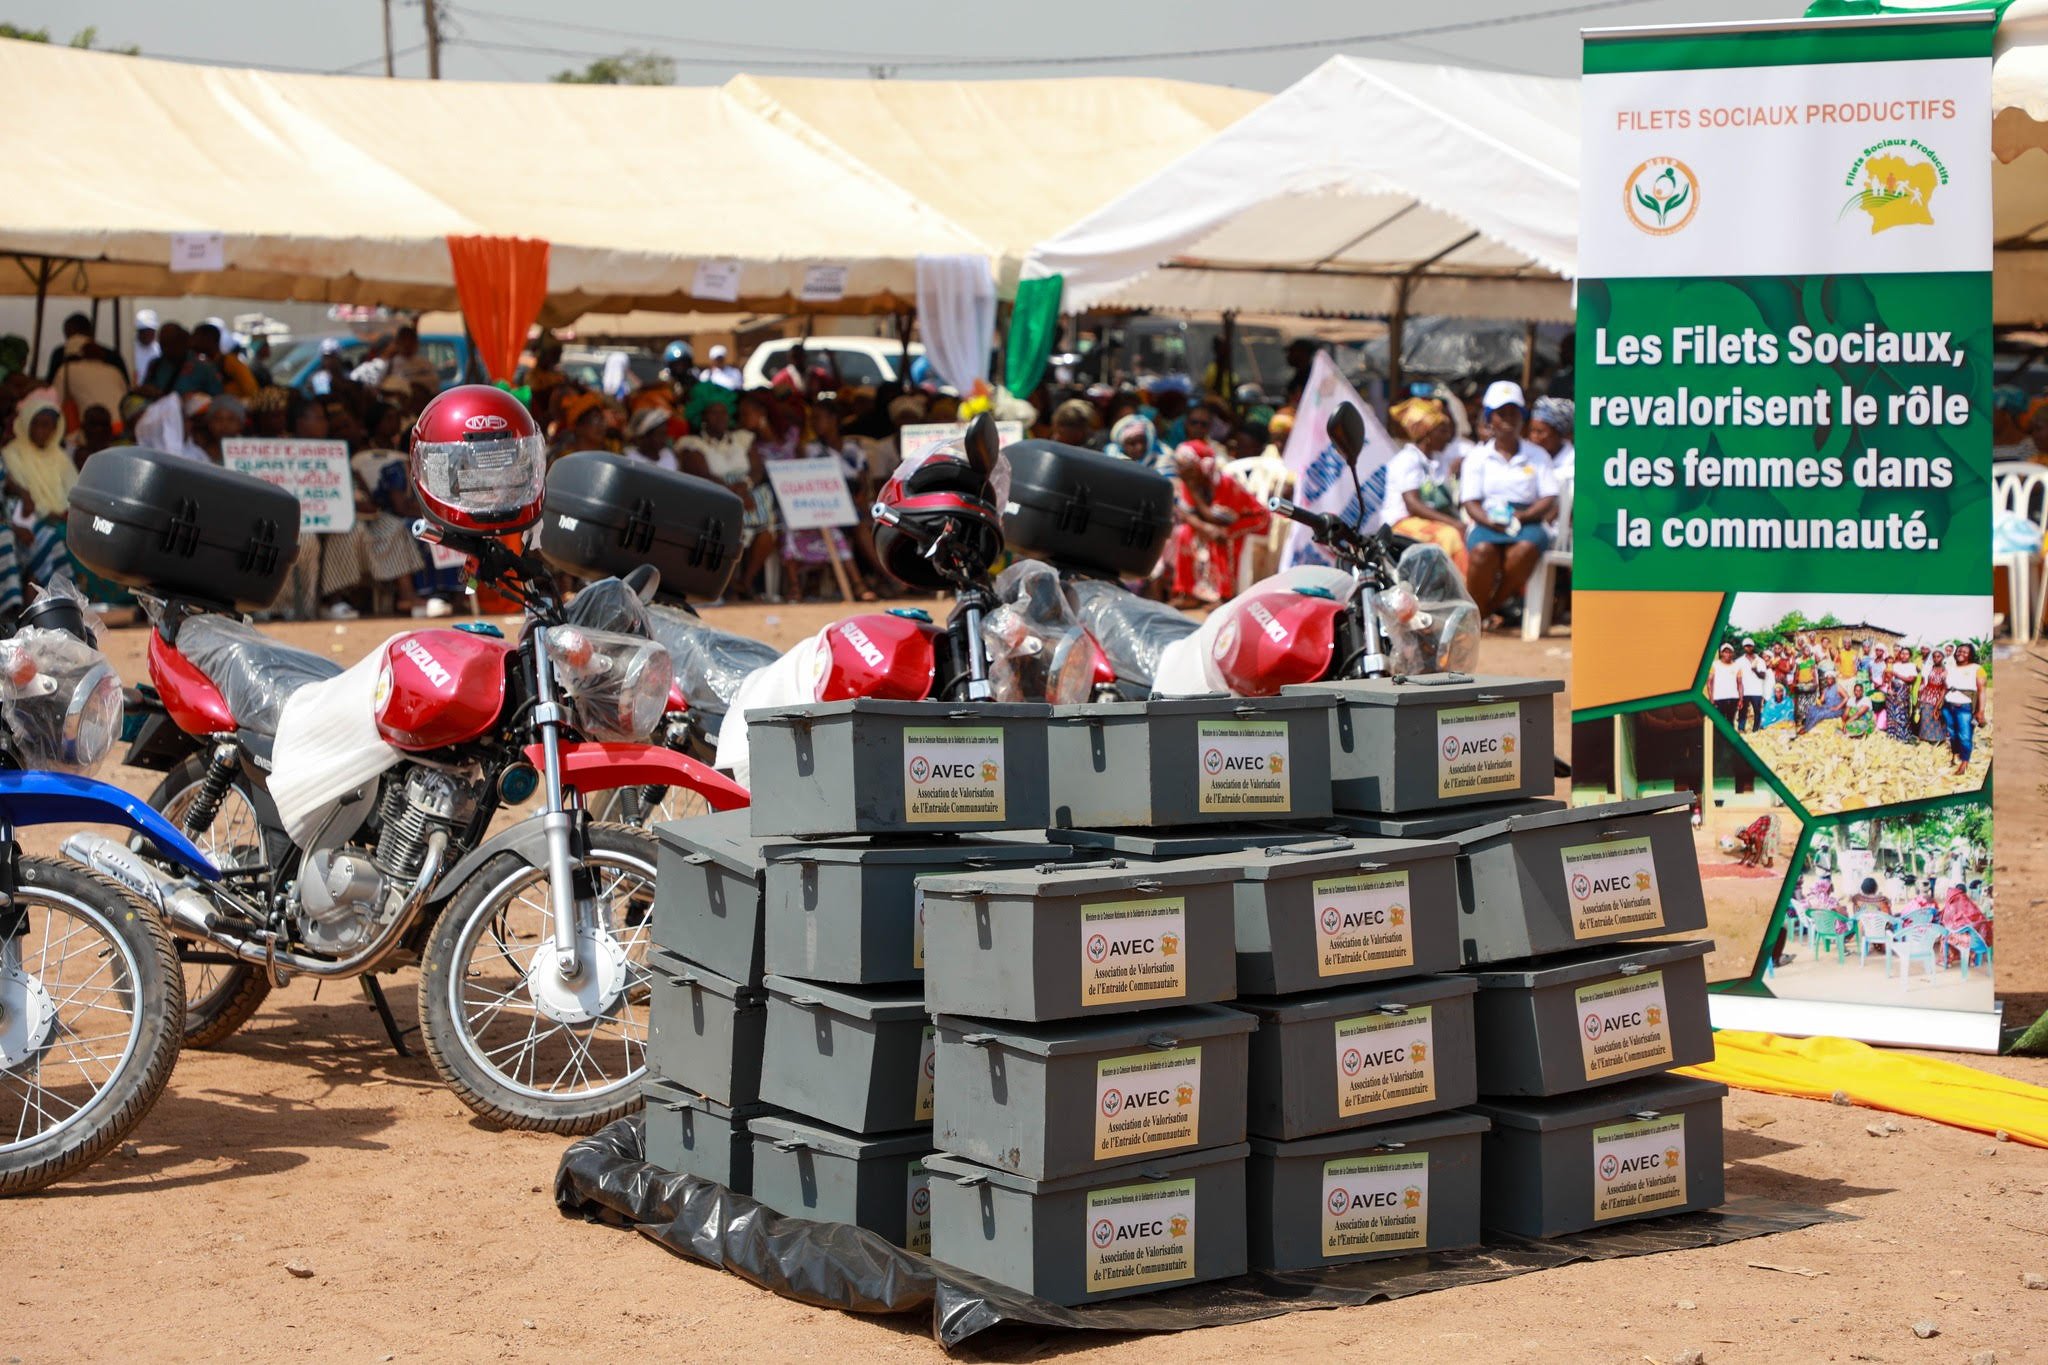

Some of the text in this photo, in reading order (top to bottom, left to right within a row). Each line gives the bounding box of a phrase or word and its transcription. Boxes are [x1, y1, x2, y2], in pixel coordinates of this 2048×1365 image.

[1617, 99, 1956, 131] FILETS SOCIAUX PRODUCTIFS
[1846, 139, 1949, 186] Filets Sociaux Productifs
[1596, 323, 1965, 367] Les Filets Sociaux,
[1590, 385, 1969, 426] revalorisent le rôle
[1604, 448, 1952, 487] des femmes dans
[1617, 509, 1939, 550] la communauté.
[1248, 601, 1288, 643] SUZUKI
[840, 622, 884, 667] SUZUKI
[401, 639, 451, 688] SUZUKI
[1461, 739, 1498, 755] AVEC
[931, 764, 975, 778] AVEC
[1225, 756, 1264, 770] AVEC
[1448, 758, 1512, 775] Association de Valorisation
[917, 787, 995, 799] Association de Valorisation
[1210, 778, 1281, 790] Association de Valorisation
[1443, 779, 1450, 790] de
[911, 802, 999, 814] de l'Entraide Communautaire
[1205, 793, 1213, 804] de
[1593, 876, 1631, 894] AVEC
[1582, 896, 1651, 915] Association de Valorisation
[1343, 910, 1384, 928] AVEC
[1579, 919, 1586, 930] de
[1109, 938, 1154, 957] AVEC
[1329, 931, 1403, 950] Association de Valorisation
[1324, 946, 1407, 966] de l'Entraide Communautaire
[1094, 961, 1175, 979] Association de Valorisation
[1088, 976, 1179, 996] de l'Entraide Communautaire
[1604, 1012, 1641, 1033] AVEC
[1593, 1031, 1661, 1055] Association de Valorisation
[1363, 1048, 1405, 1068] AVEC
[1590, 1060, 1598, 1071] de
[1350, 1068, 1424, 1091] Association de Valorisation
[1124, 1090, 1170, 1110] AVEC
[1344, 1082, 1428, 1108] de l'Entraide Communautaire
[1107, 1112, 1188, 1134] Association de Valorisation
[1101, 1126, 1191, 1150] de l'Entraide Communautaire
[1620, 1154, 1660, 1174] AVEC
[1606, 1173, 1677, 1195] Association de Valorisation
[1351, 1192, 1397, 1209] AVEC
[1600, 1200, 1608, 1211] de
[1116, 1221, 1163, 1241] AVEC
[1334, 1214, 1416, 1231] Association de Valorisation
[1328, 1228, 1420, 1247] de l'Entraide Communautaire
[1099, 1243, 1183, 1265] Association de Valorisation
[1093, 1258, 1187, 1281] de l'Entraide Communautaire
